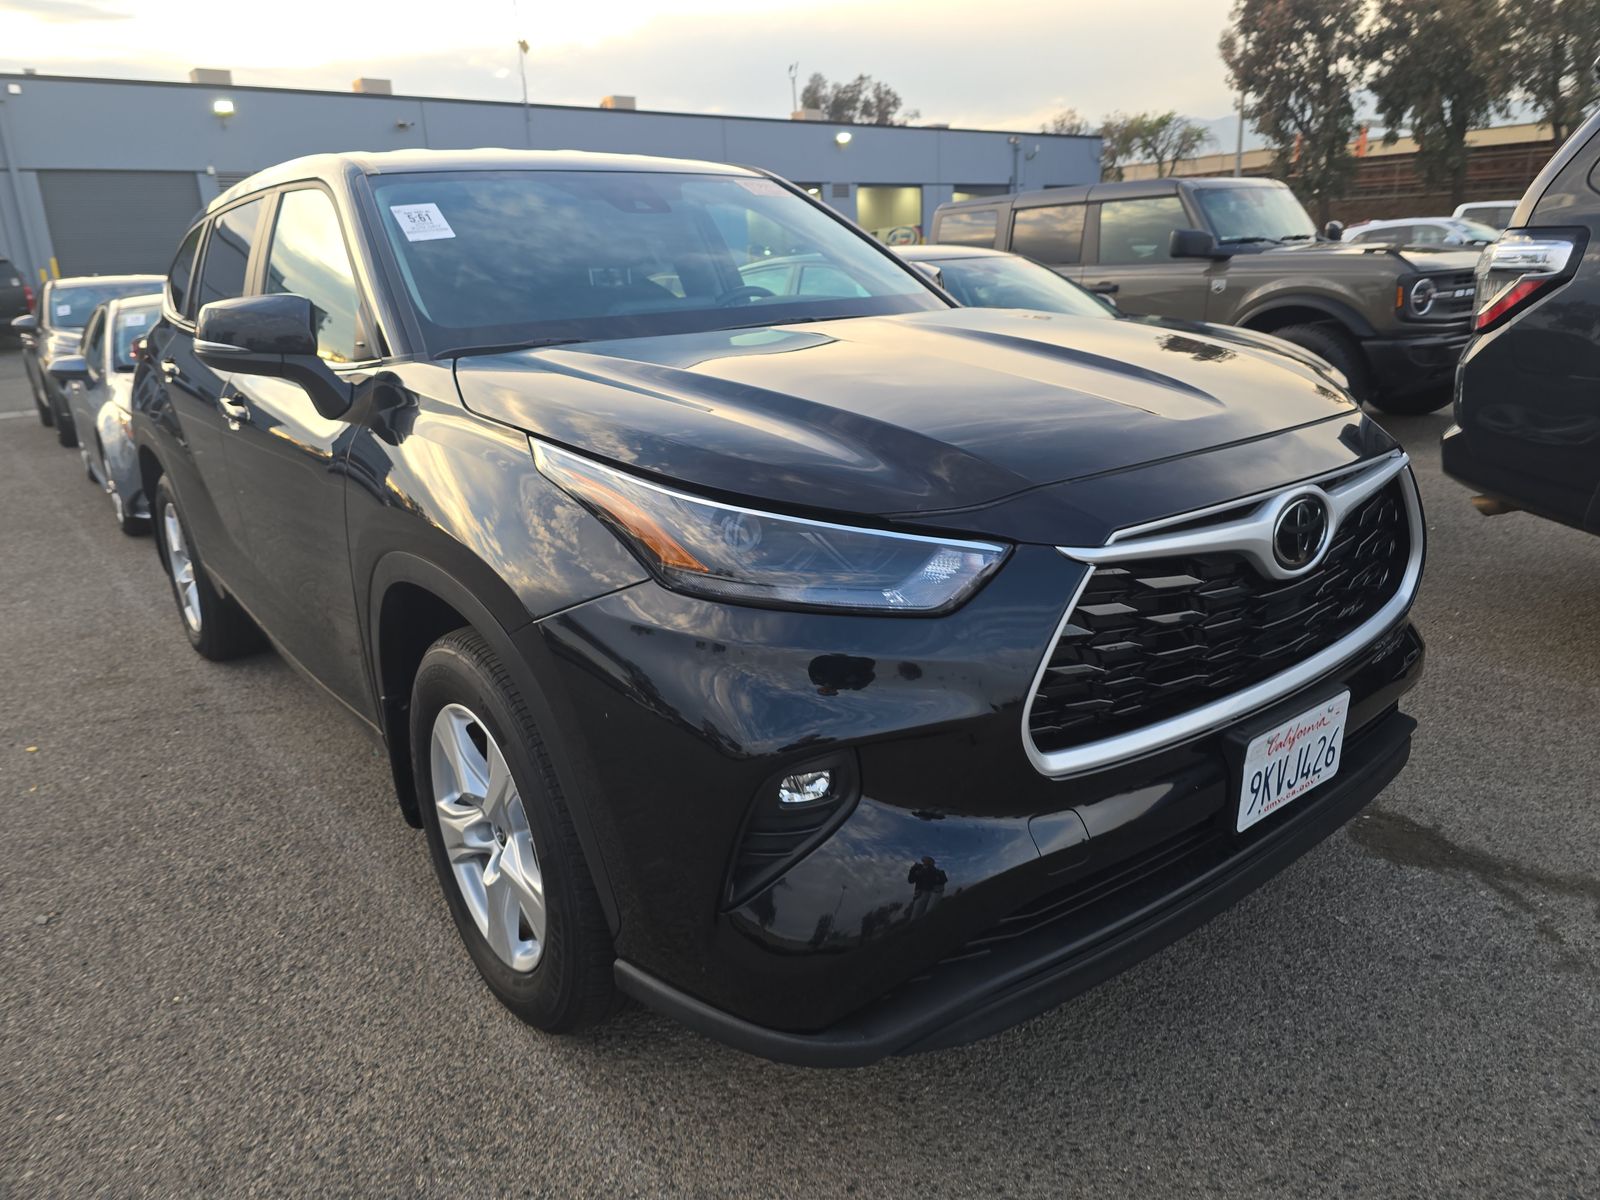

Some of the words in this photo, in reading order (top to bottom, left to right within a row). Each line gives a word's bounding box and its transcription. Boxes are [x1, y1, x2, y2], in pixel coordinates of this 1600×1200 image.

[1267, 713, 1330, 757] California
[1247, 726, 1340, 816] 9KVJ426
[1263, 778, 1317, 813] dmv.ca.gov
